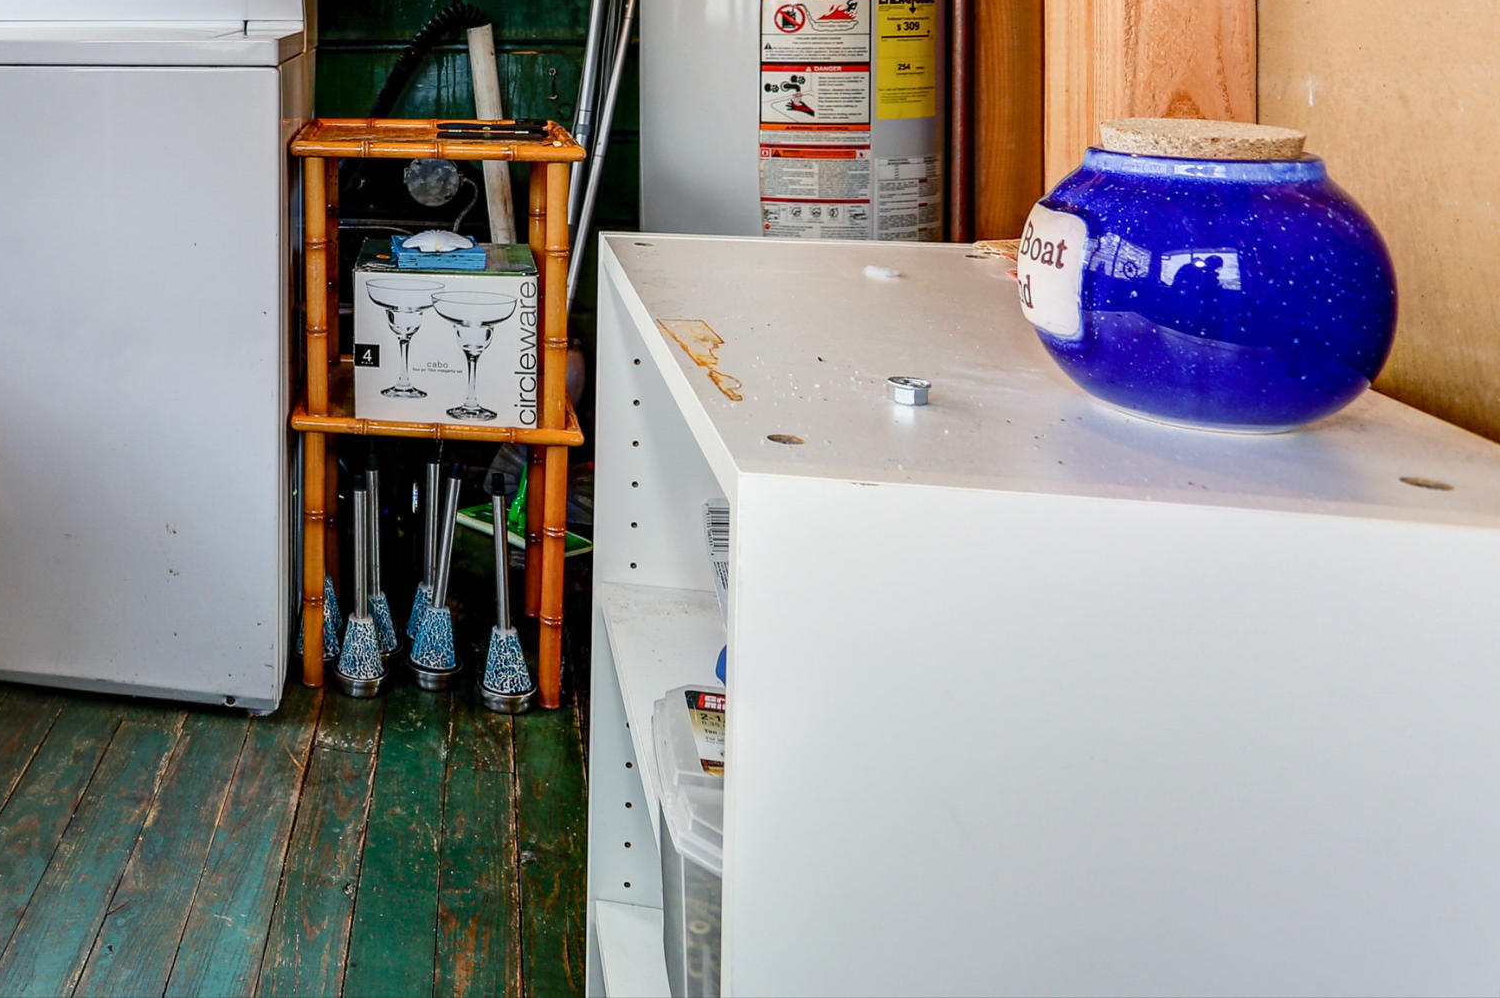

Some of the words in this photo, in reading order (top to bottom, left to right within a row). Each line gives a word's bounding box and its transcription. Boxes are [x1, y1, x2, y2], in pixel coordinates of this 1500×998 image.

[1020, 220, 1068, 269] Boat
[362, 349, 372, 362] 4
[514, 281, 536, 425] circleware
